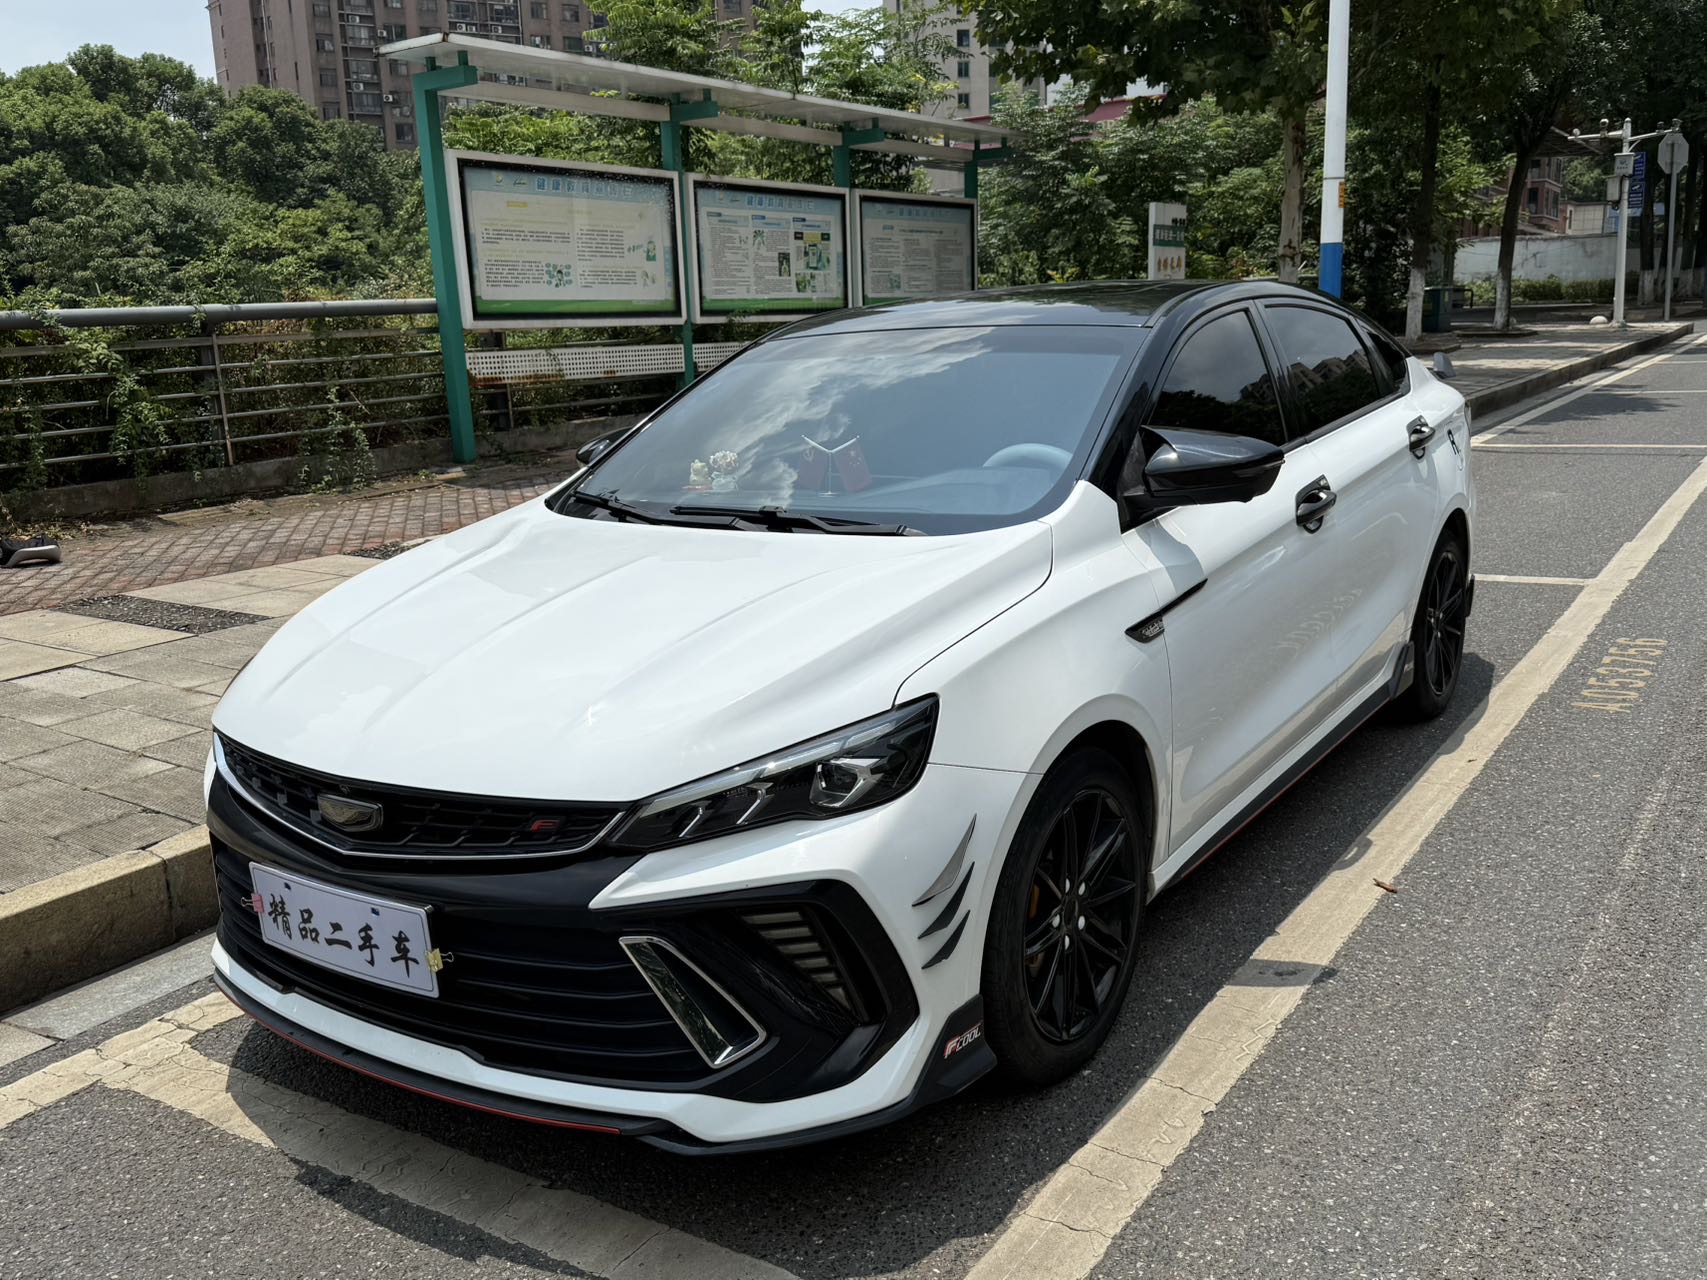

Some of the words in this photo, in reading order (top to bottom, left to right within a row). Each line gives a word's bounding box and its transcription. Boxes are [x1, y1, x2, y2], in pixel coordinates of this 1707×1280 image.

[1570, 638, 1668, 713] A053756
[267, 894, 419, 978] 精品二手车
